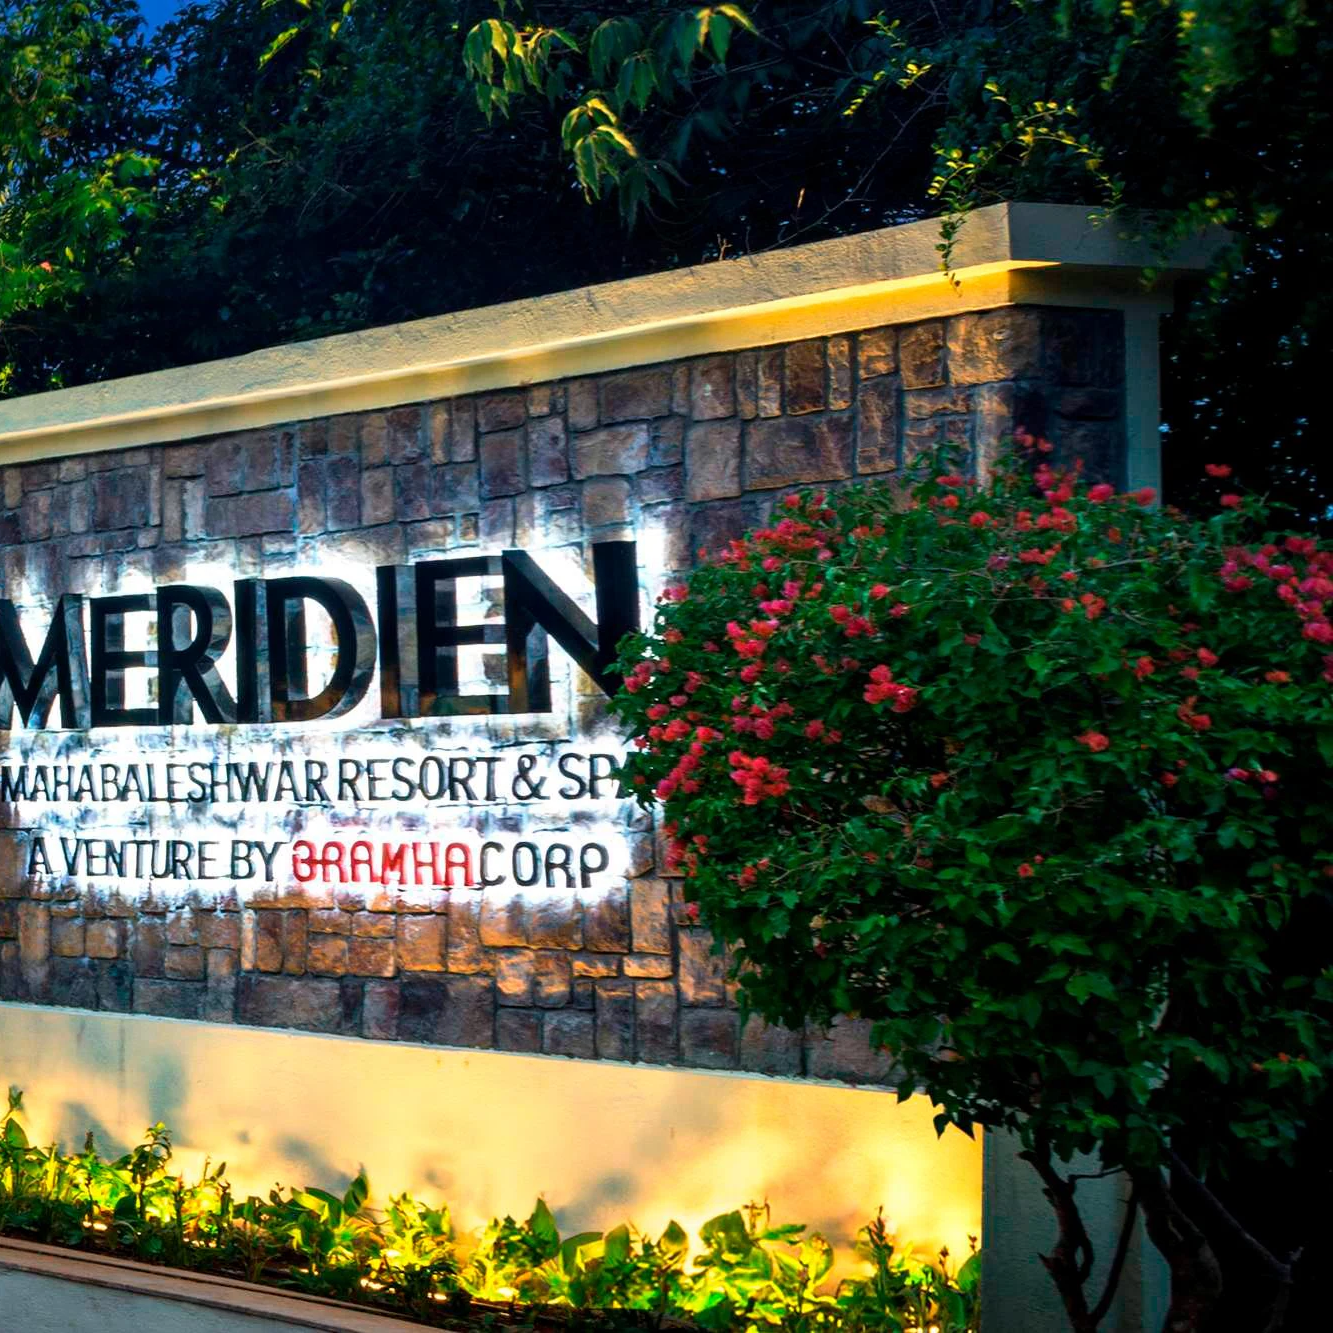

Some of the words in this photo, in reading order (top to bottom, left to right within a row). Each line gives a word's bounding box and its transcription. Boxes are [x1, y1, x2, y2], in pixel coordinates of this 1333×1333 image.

[0, 759, 331, 803] MAHABALESHWAR
[337, 755, 506, 802] RESORT
[511, 753, 551, 801] &
[28, 836, 54, 875] A
[60, 837, 221, 881] VENTURE
[230, 839, 287, 883] BY
